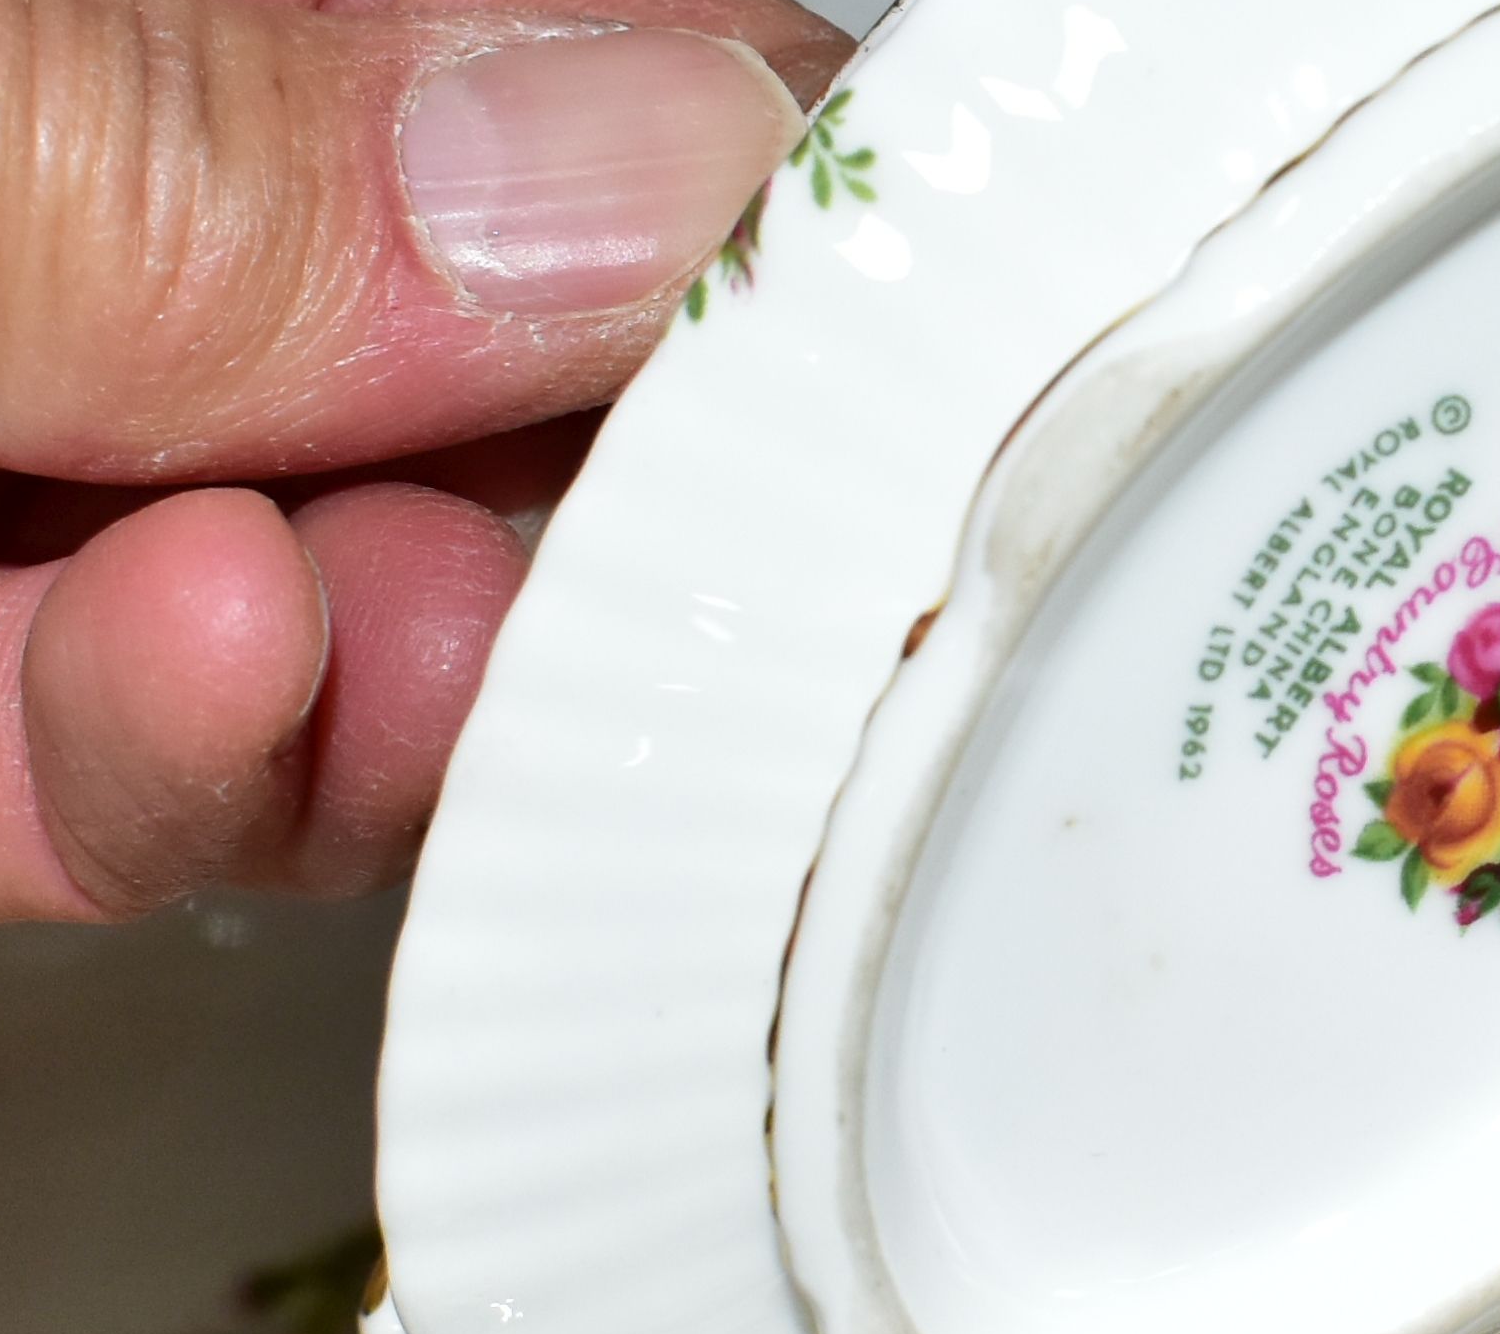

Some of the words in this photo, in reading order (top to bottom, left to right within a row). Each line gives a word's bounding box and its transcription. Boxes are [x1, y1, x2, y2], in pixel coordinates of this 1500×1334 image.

[1320, 415, 1422, 495] ROYAL
[1231, 496, 1316, 612] ALBERT
[1240, 486, 1381, 669] ENGLAND
[1331, 483, 1422, 590] BONE
[1364, 467, 1473, 593] ROYAL
[1198, 624, 1236, 683] LTD
[1246, 598, 1332, 705] CHINA
[1254, 606, 1363, 760] ALBERT
[1177, 702, 1214, 783] 1962
[1308, 726, 1369, 880] Roses
